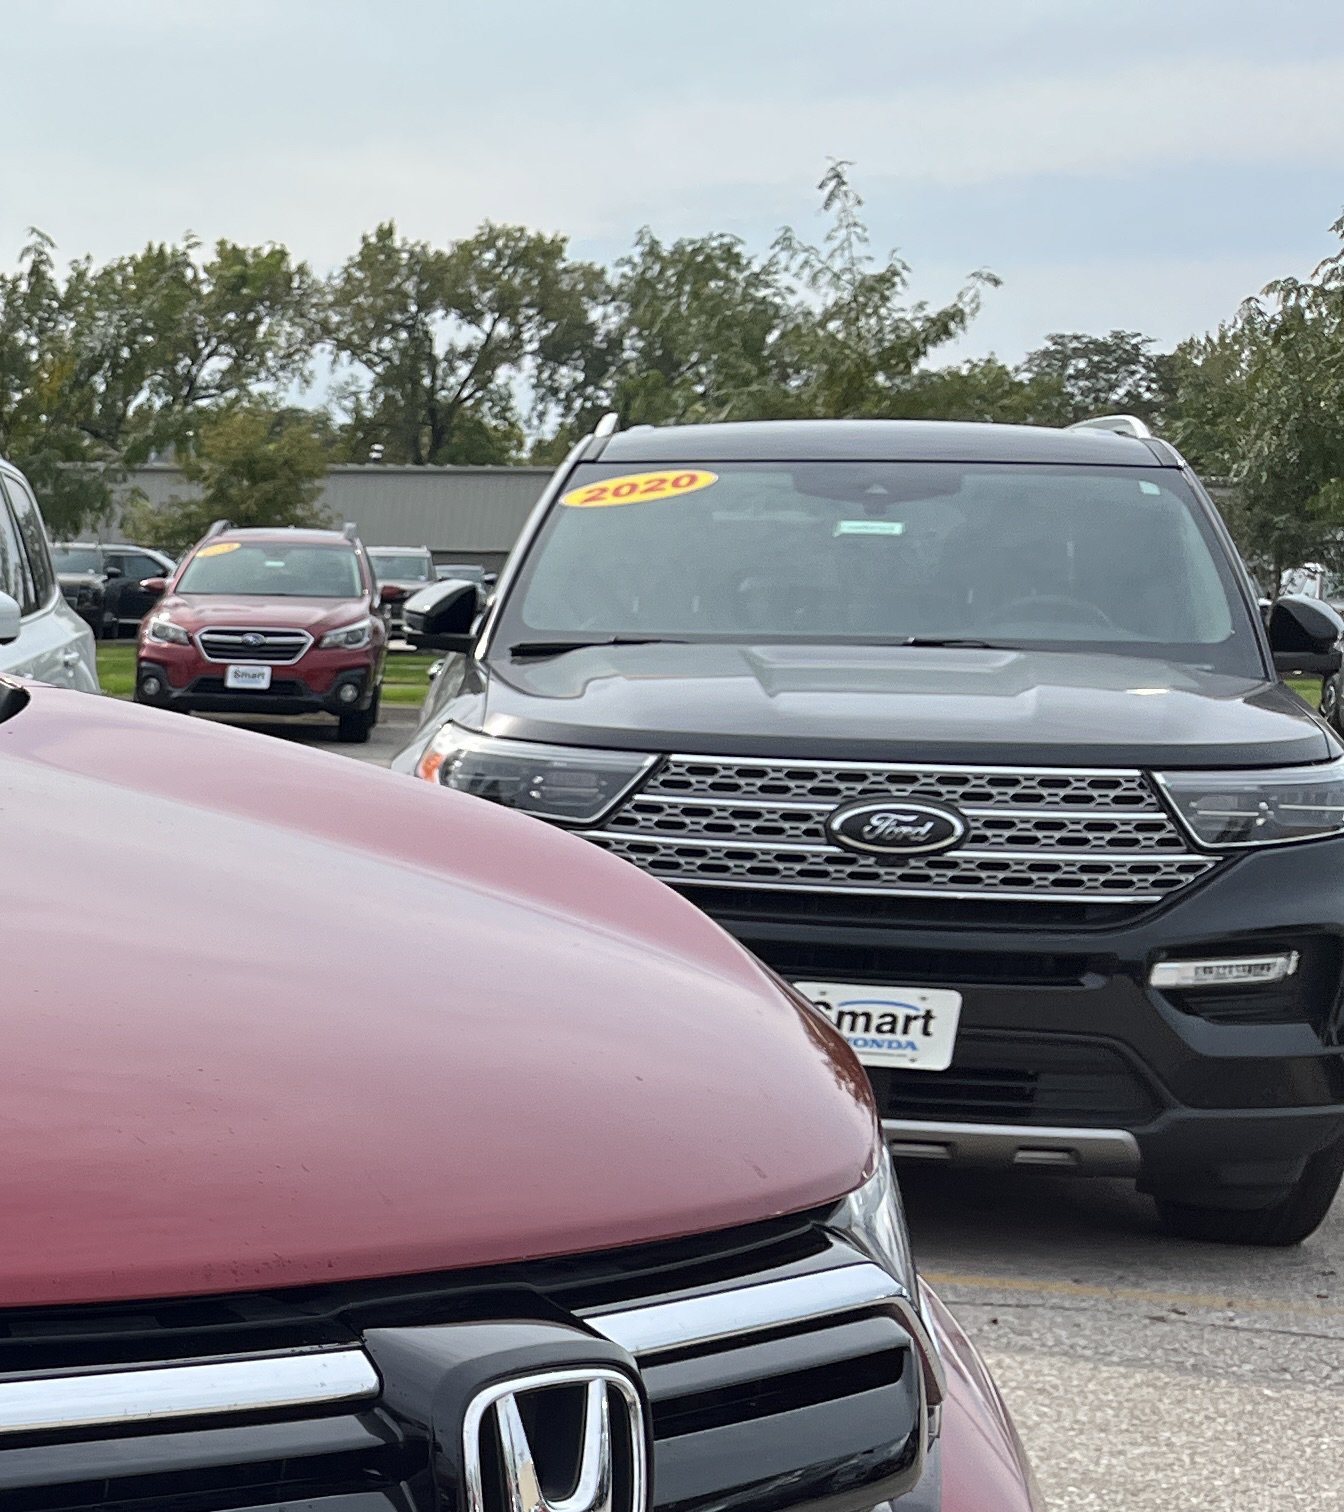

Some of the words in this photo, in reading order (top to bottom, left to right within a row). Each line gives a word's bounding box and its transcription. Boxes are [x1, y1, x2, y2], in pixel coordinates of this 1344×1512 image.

[579, 473, 698, 505] 2020
[862, 812, 935, 842] Ford
[847, 1037, 920, 1052] ONDA
